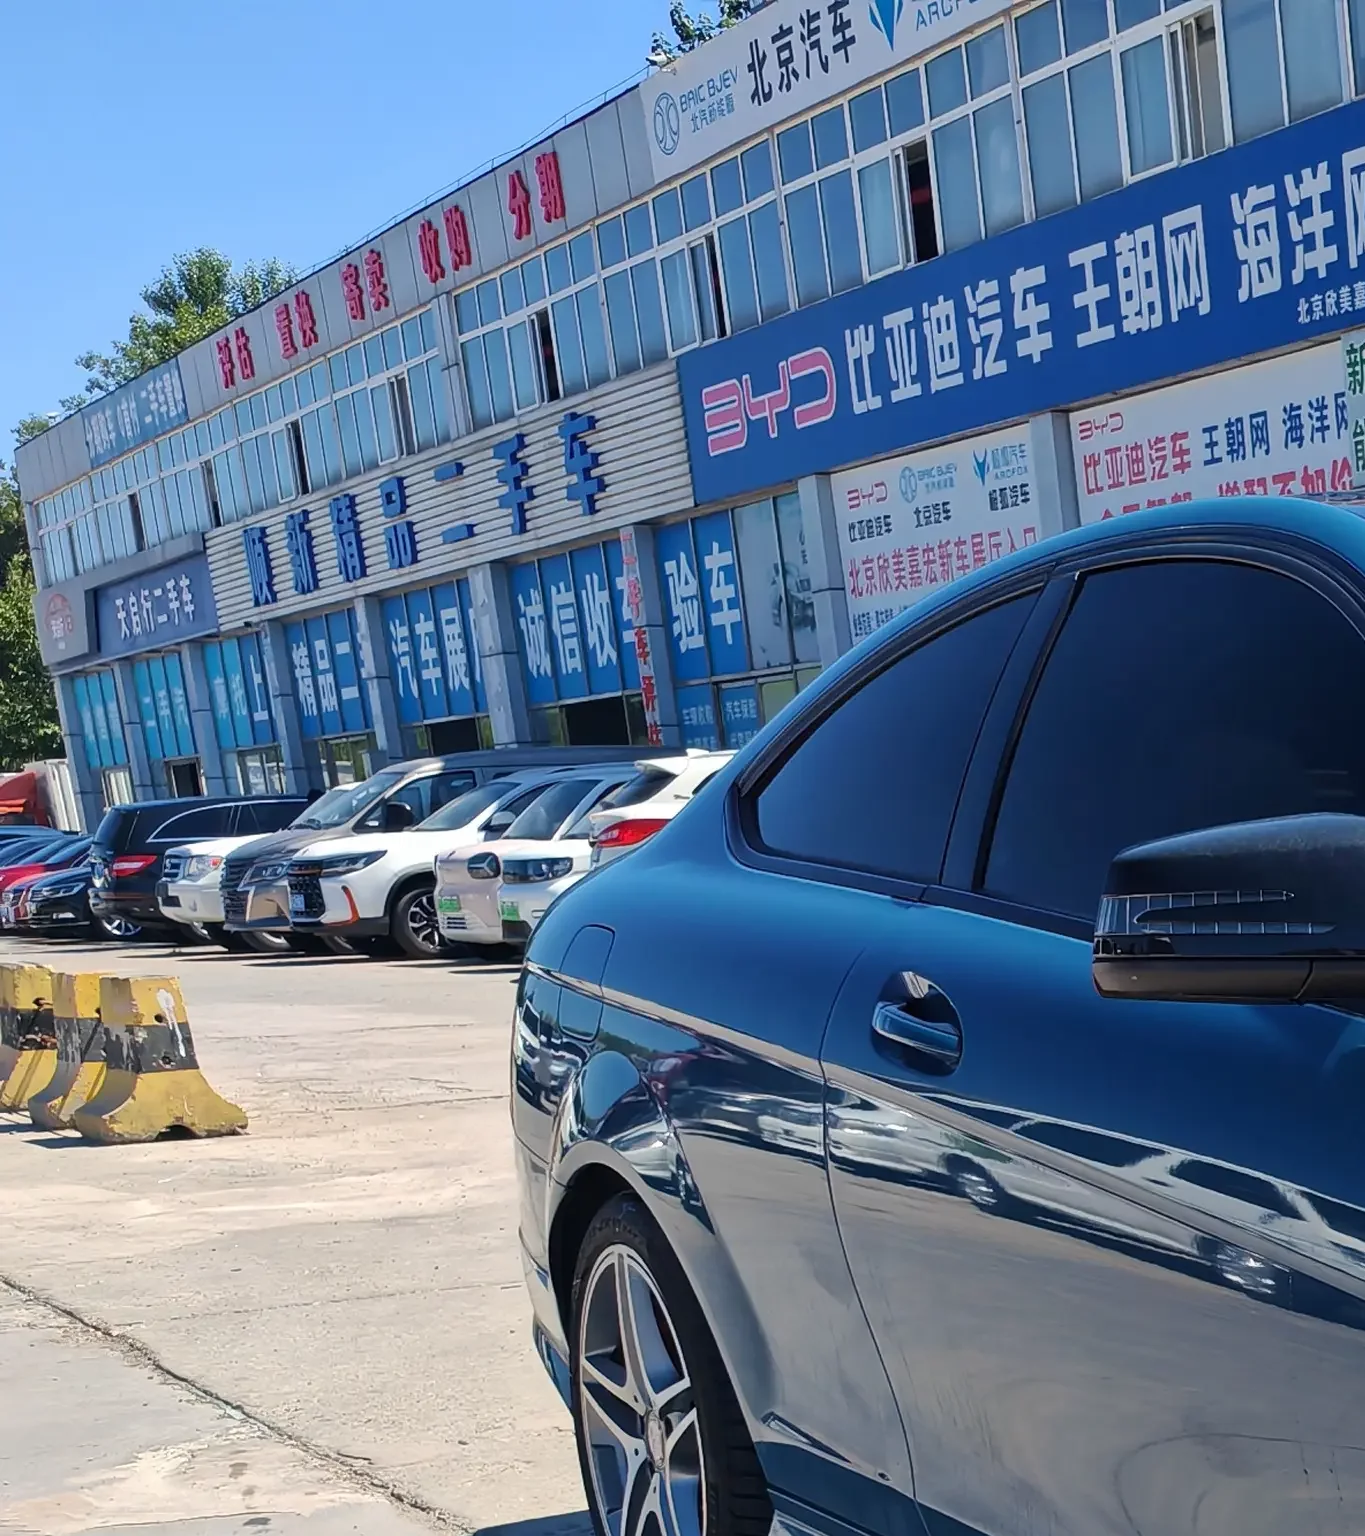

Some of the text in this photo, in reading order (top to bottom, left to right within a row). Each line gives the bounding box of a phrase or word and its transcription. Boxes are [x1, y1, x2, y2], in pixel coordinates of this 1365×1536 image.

[680, 65, 739, 113] BAIC BJEV
[748, 0, 856, 106] 北京汽车
[274, 289, 319, 360] 置换
[418, 205, 472, 284] 收购
[508, 151, 565, 240] 分期
[702, 346, 837, 457] BYD
[845, 264, 1052, 414] 比亚迪汽车
[1072, 204, 1211, 350] 王朝网
[1078, 412, 1124, 441] BYD
[1083, 431, 1192, 496] 比亚迪汽车
[1202, 410, 1271, 467] 王朝网
[847, 481, 889, 510] BYD
[664, 541, 741, 654] 验车
